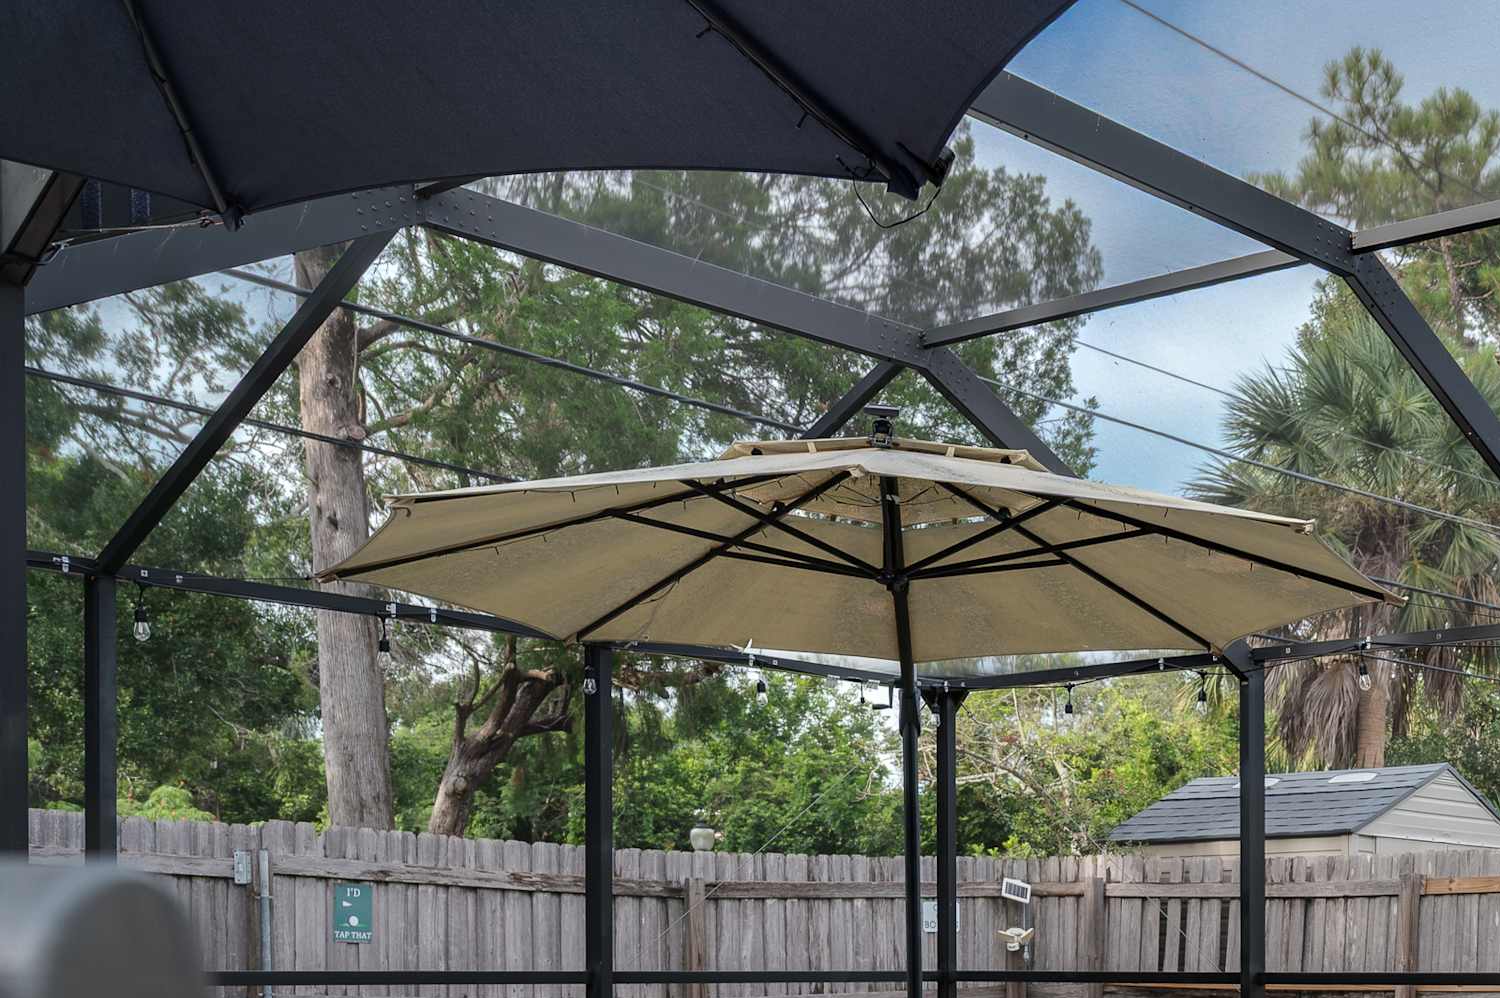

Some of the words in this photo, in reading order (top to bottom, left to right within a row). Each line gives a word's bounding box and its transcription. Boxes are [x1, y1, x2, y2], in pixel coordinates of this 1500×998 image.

[347, 887, 361, 898] I'D
[334, 930, 351, 939] TAP
[351, 931, 372, 940] THAT
